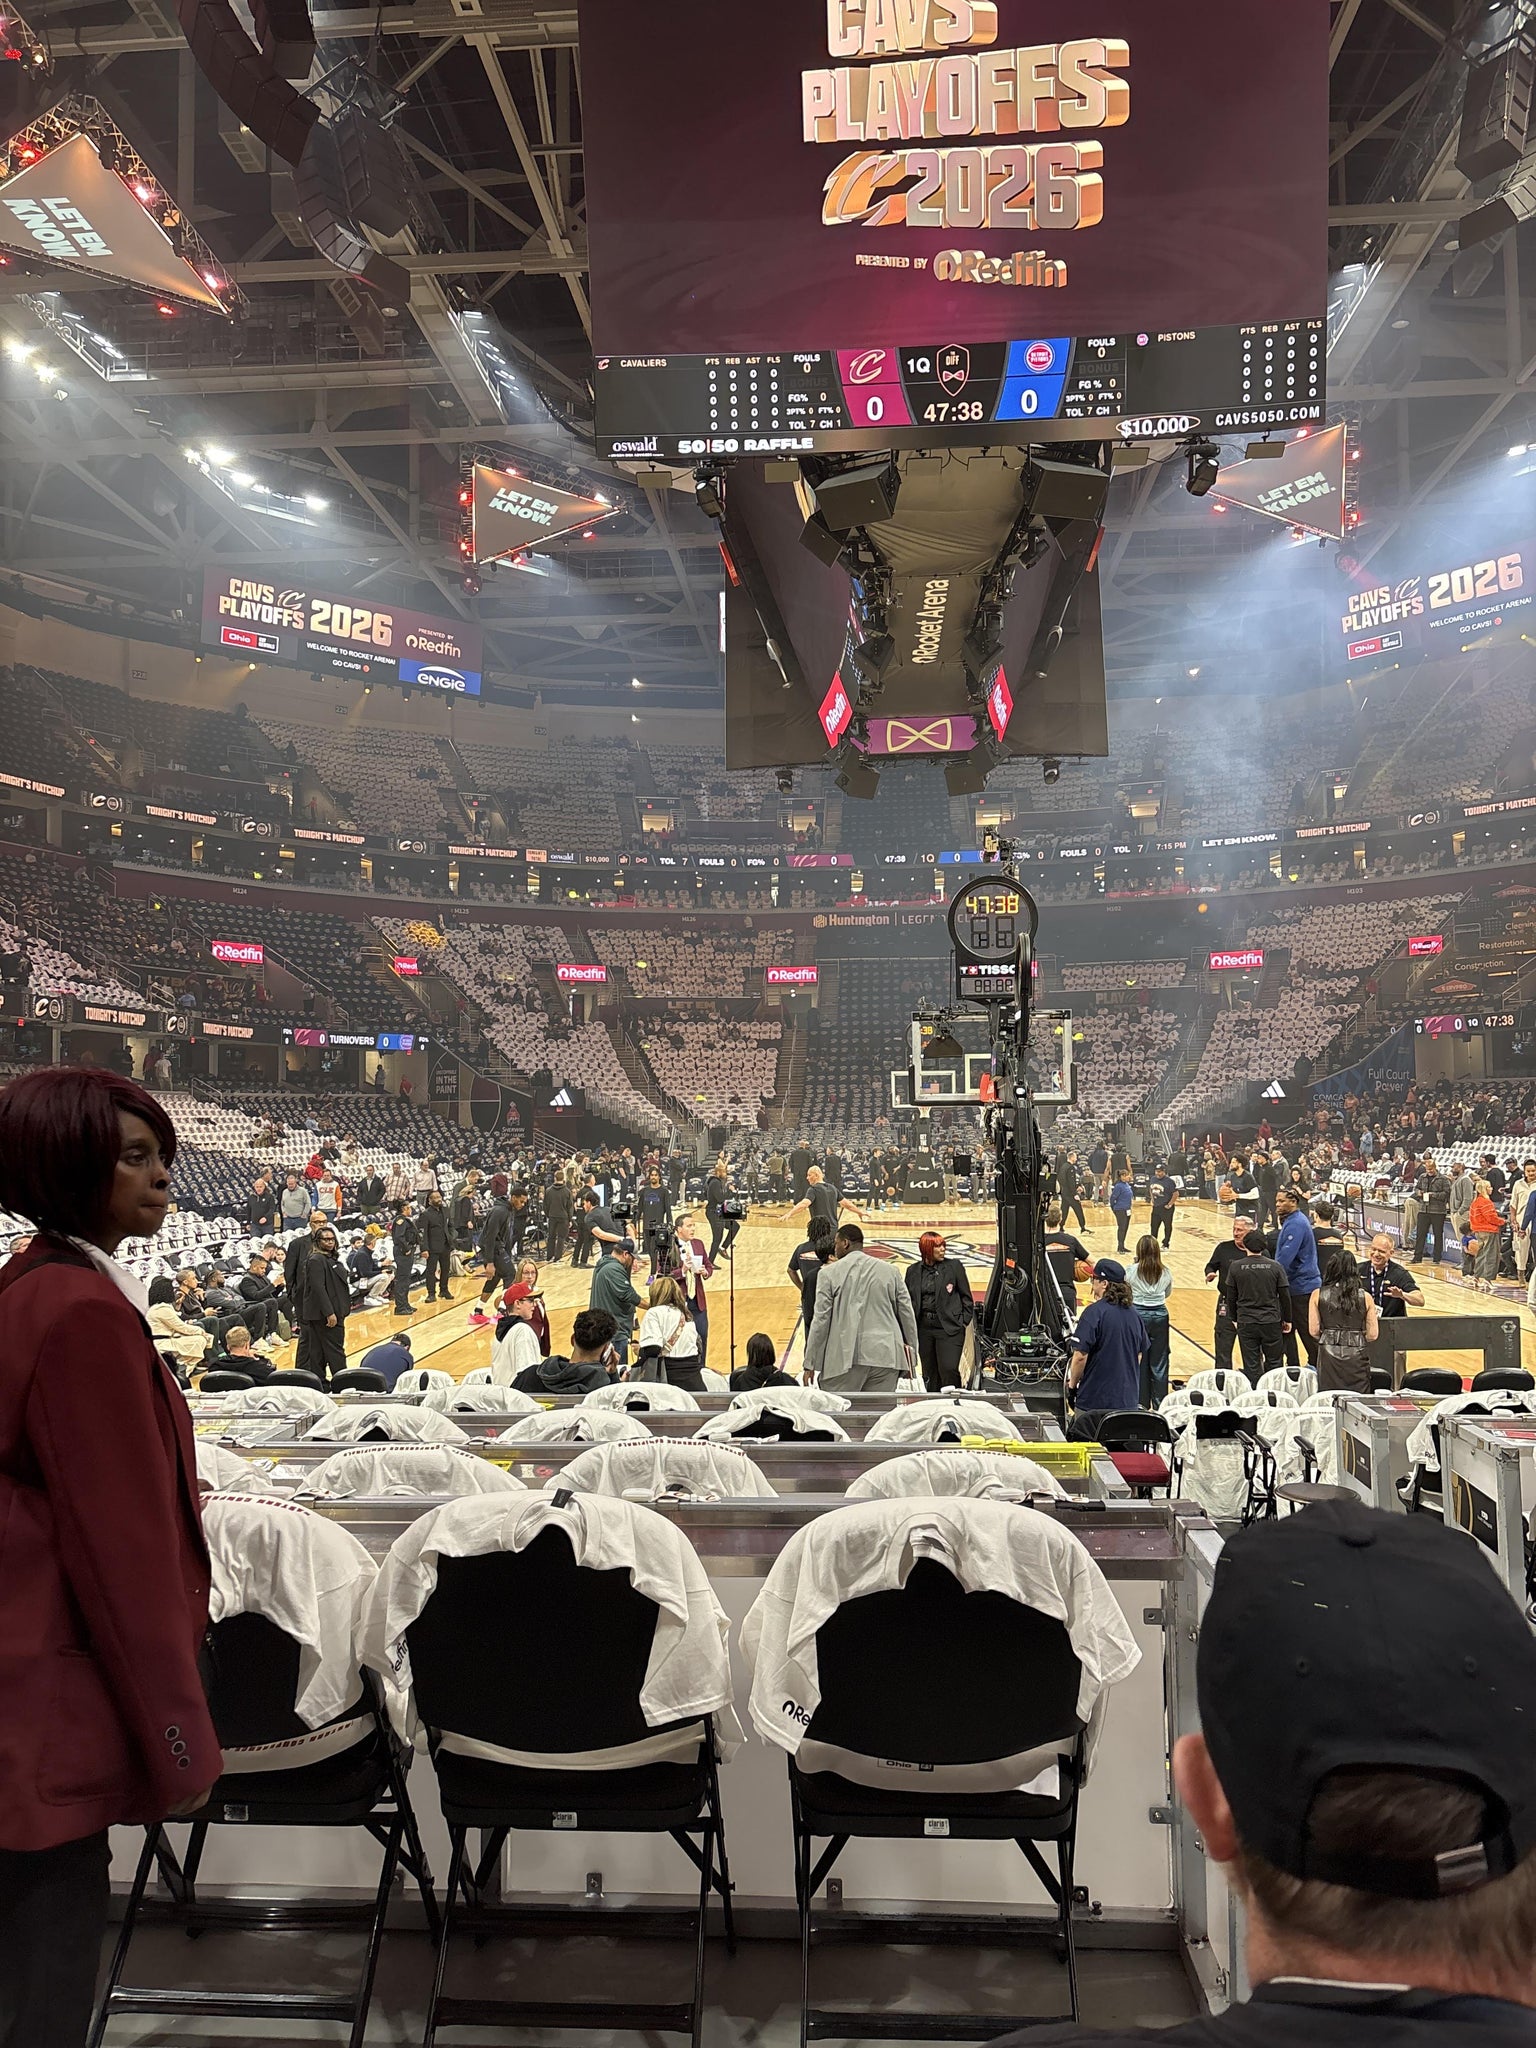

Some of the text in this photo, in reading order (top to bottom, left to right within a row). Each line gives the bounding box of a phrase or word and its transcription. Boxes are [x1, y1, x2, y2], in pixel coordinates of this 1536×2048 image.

[827, 0, 997, 58] CAVS
[802, 38, 1129, 143] PLAYOFFS
[906, 140, 1103, 230] 2026
[41, 197, 114, 256] LET EM
[855, 247, 1068, 288] PRESENTED BY Redfin
[1157, 320, 1322, 343] PISTONS PTS REB AST FLS
[1087, 338, 1116, 348] FOULS
[793, 354, 821, 363] FOULS
[1097, 347, 1106, 358] 0
[1309, 347, 1318, 357] 0
[620, 355, 781, 369] CAVALIERS PTS REB AST FLS
[803, 362, 811, 374] 0
[906, 357, 931, 374] 1Q
[945, 355, 960, 367] DIFF
[708, 368, 778, 380] 0 0 0 0
[709, 381, 778, 393] 0 0 0 0
[1109, 378, 1117, 388] 0
[787, 391, 827, 403] FG% 0
[1020, 389, 1038, 414] 0
[1065, 391, 1122, 403] 3PT% 0 FT% 0
[786, 405, 841, 416] 3PT% 0 FT% 0
[866, 395, 884, 421] 0
[923, 401, 984, 424] 47:38
[1065, 405, 1121, 417] TOL 7 CH 1
[612, 406, 1320, 452] oswald RAFFLE $10,000 CAVS5050.COM
[788, 419, 842, 430] TOL 7 CH 1
[1257, 471, 1326, 505] LET EM
[496, 487, 560, 515] LET EM
[1263, 482, 1337, 513] KNOW.
[488, 497, 552, 526] KNOW.
[229, 578, 275, 604] CAVS
[1341, 553, 1523, 634] PLAYOFFS 2026
[1348, 585, 1391, 613] CAVS
[912, 579, 950, 659] Rocket Arena
[1429, 596, 1533, 629] WELCOME TO ROCKET ARENA!
[218, 595, 393, 647] PLAYOFFS 2026
[1459, 619, 1492, 634] GO CAVS!
[228, 632, 252, 644] Ohio
[418, 627, 446, 639] PRESENTED
[306, 641, 339, 655] WELCOME
[339, 648, 348, 656] TO
[348, 649, 374, 661] ROCKET
[419, 638, 461, 660] Redfin
[1354, 642, 1376, 654] Ohio
[332, 658, 362, 671] GO CAVS!
[32, 781, 65, 798] MATCHUP
[145, 805, 217, 825] TONIGHT'S MATCHUP
[1463, 803, 1505, 817] TONIGHT'S
[293, 828, 365, 845] TONIGHT'S MATCHUP
[1296, 822, 1371, 838] TONIGHT'S MATCHUP
[1202, 833, 1278, 848] LET EM KNOW.
[448, 845, 485, 856] TONIGHT'S
[485, 847, 518, 858] MATCHUP
[1060, 841, 1187, 858] FOULS 0 TOL 7 7:15 PM
[550, 852, 574, 862] oswald
[585, 855, 609, 863] $10,000
[659, 857, 779, 867] TOL 7 FOULS 0 FG% 0
[830, 855, 837, 865] 0
[884, 853, 935, 864] 47:38 1Q
[954, 853, 961, 862] 0
[965, 893, 1020, 915] 47:38
[829, 914, 890, 927] Huntington
[1479, 939, 1527, 952] Restoration.
[224, 946, 263, 963] Redfin
[1223, 953, 1263, 967] Redfin
[1455, 959, 1506, 972] Construction.
[569, 966, 606, 980] Redfin
[779, 968, 816, 980] Redfin
[667, 1001, 717, 1010] LET EM
[85, 1007, 146, 1027] TONIGHT'S MATCHUP
[1454, 1014, 1514, 1031] 0 1Q 47:38
[202, 1021, 254, 1039] TONIGHT'S MATCHUP
[1416, 1025, 1422, 1034] 0
[319, 1033, 389, 1047] 0 TURNOVERS 0
[436, 1075, 457, 1084] IN THE
[1368, 1068, 1410, 1080] Full Court
[436, 1085, 457, 1095] PAINT
[1376, 1080, 1404, 1093] Power
[319, 1186, 334, 1195] CLE
[1251, 1263, 1272, 1271] CREW
[886, 1760, 913, 1769] Ohio
